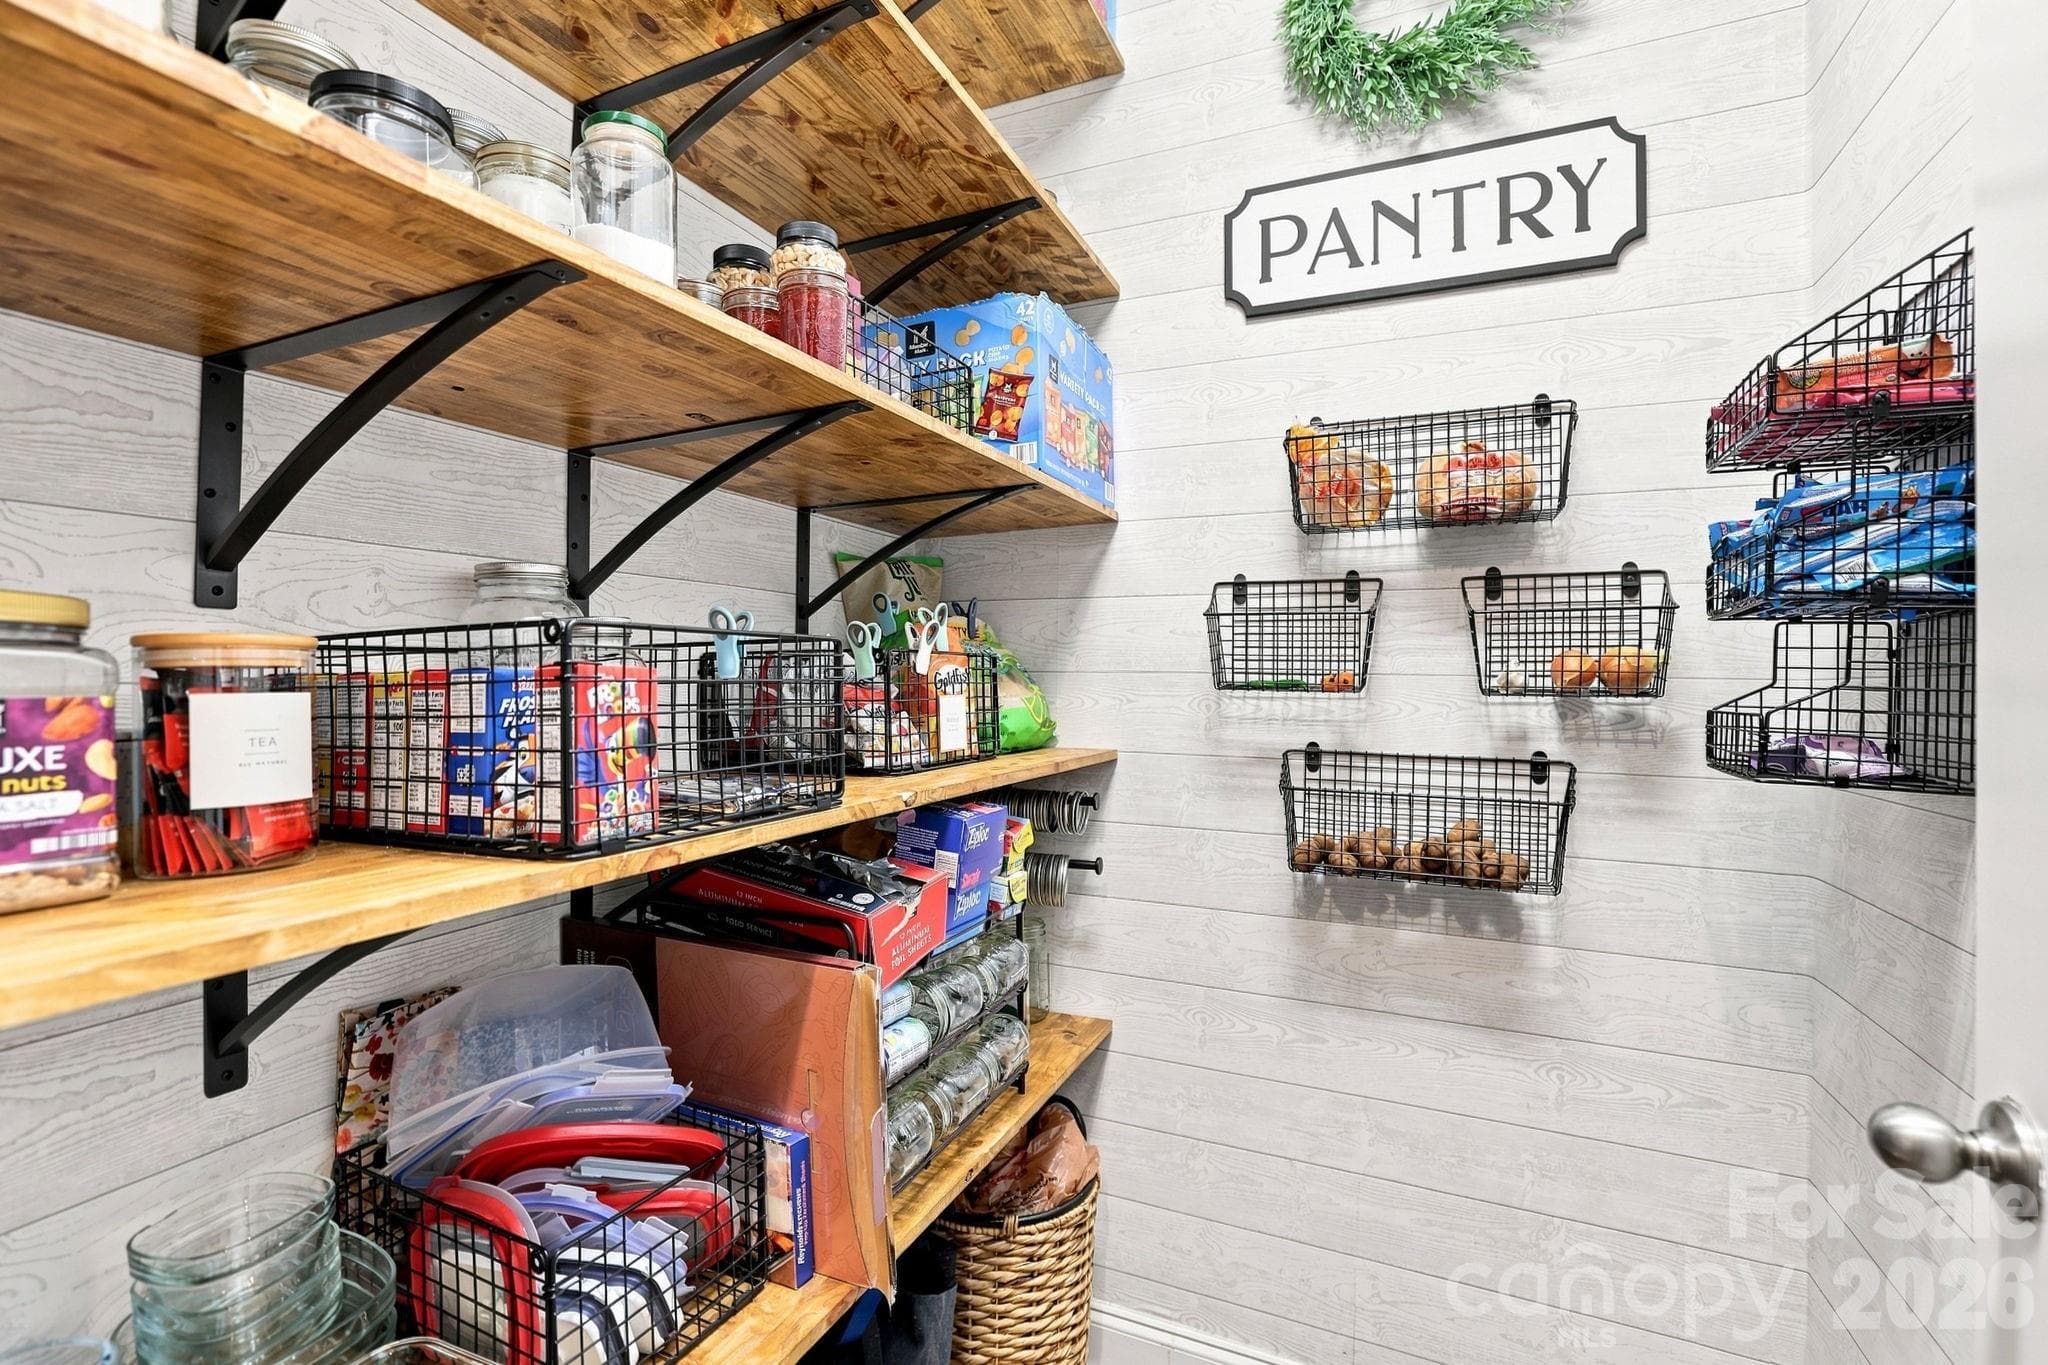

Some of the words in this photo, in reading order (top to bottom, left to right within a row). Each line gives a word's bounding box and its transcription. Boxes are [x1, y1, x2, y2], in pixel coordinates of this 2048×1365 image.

[1258, 157, 1608, 284] PANTRY
[1016, 301, 1035, 315] 42
[248, 737, 278, 748] TEA
[2, 775, 67, 794] nuts
[967, 826, 990, 850] Ziploc
[745, 892, 763, 904] INCH
[956, 890, 981, 918] Ziploc
[725, 916, 744, 928] FOOD
